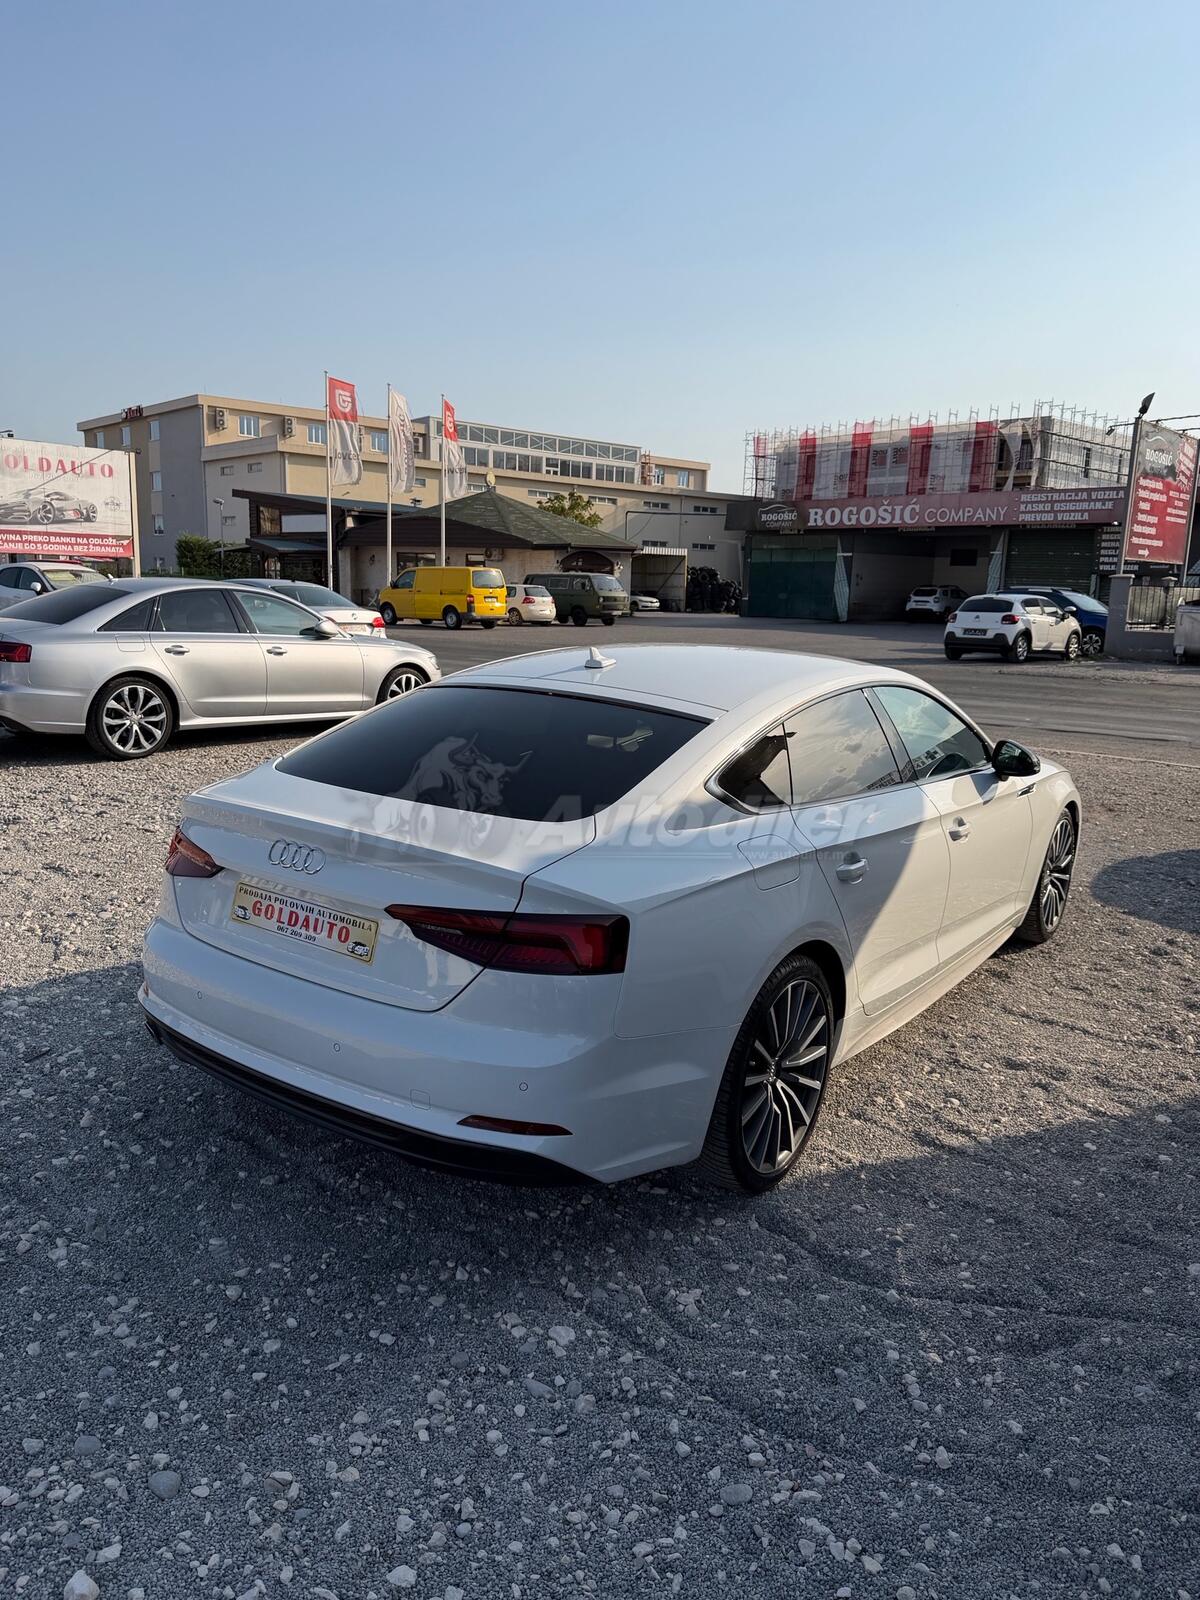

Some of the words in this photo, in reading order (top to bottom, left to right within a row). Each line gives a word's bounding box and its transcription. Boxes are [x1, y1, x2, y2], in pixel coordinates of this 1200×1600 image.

[1021, 492, 1088, 502] REGISTRACIJA
[1091, 490, 1125, 500] VOZILA
[808, 498, 920, 527] ROGOŠIĆ
[924, 506, 1009, 523] COMPANY
[1020, 503, 1051, 512] KASKO
[1054, 501, 1114, 511] OSIGURANJE
[761, 510, 798, 522] ROGOŠIĆ
[1019, 512, 1054, 522] PREVOD
[1057, 512, 1089, 521] VOZILA
[766, 521, 792, 529] COMPANY
[23, 534, 49, 543] PREKO
[50, 535, 77, 544] BANKE
[78, 536, 89, 545] NA
[24, 542, 36, 550] DO
[37, 543, 43, 551] 5
[43, 544, 72, 552] GODINA
[73, 545, 88, 553] BEZ
[88, 545, 125, 554] ŽIRANATA
[239, 886, 273, 903] PRODAJA
[274, 896, 315, 914] POLOVNIH
[316, 909, 373, 932] AUTOMOBILA
[252, 899, 350, 944] GOLDAUTO
[276, 925, 289, 935] 067
[290, 928, 302, 938] 209
[303, 932, 317, 943] 309
